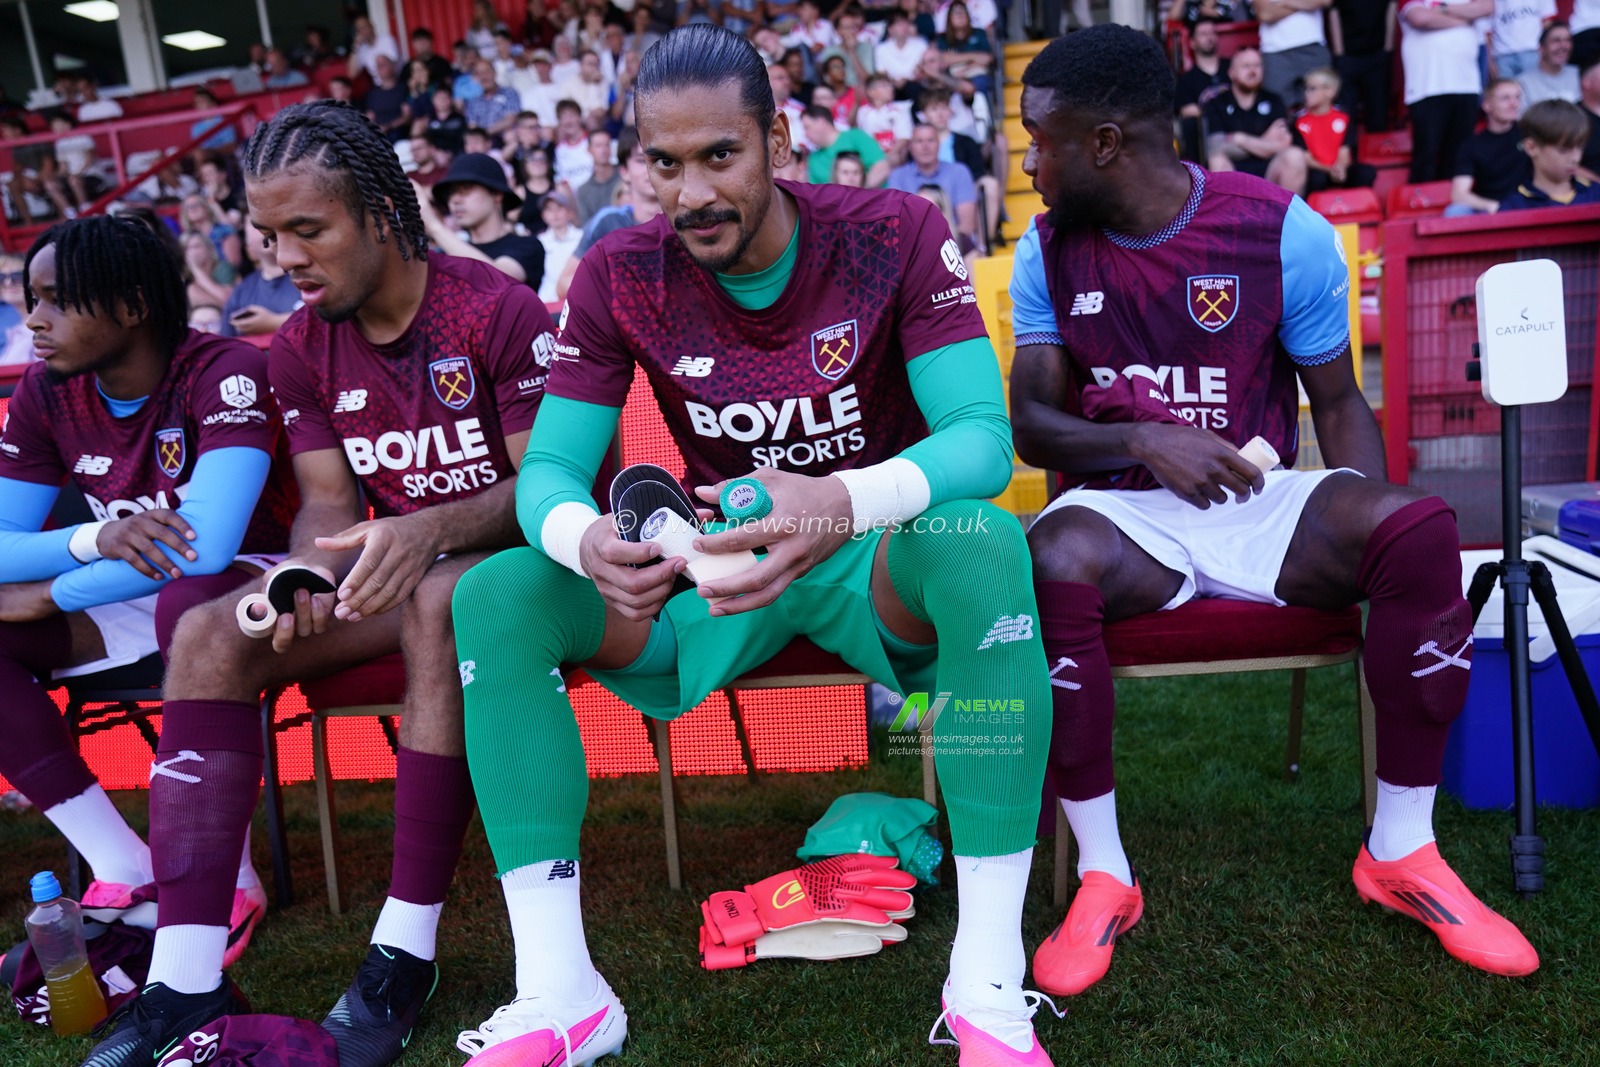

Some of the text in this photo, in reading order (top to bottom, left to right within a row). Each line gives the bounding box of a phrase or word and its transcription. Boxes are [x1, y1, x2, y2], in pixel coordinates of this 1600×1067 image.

[931, 287, 962, 303] LILLEY
[816, 324, 852, 341] WEST HAM
[1495, 321, 1555, 336] CATAPULT
[518, 376, 545, 390] LILLEY
[684, 383, 862, 442] BOYLE
[343, 417, 489, 475] BOYLE
[751, 427, 866, 469] SPORTS
[402, 460, 498, 498] SPORTS
[722, 898, 740, 918] FONZI
